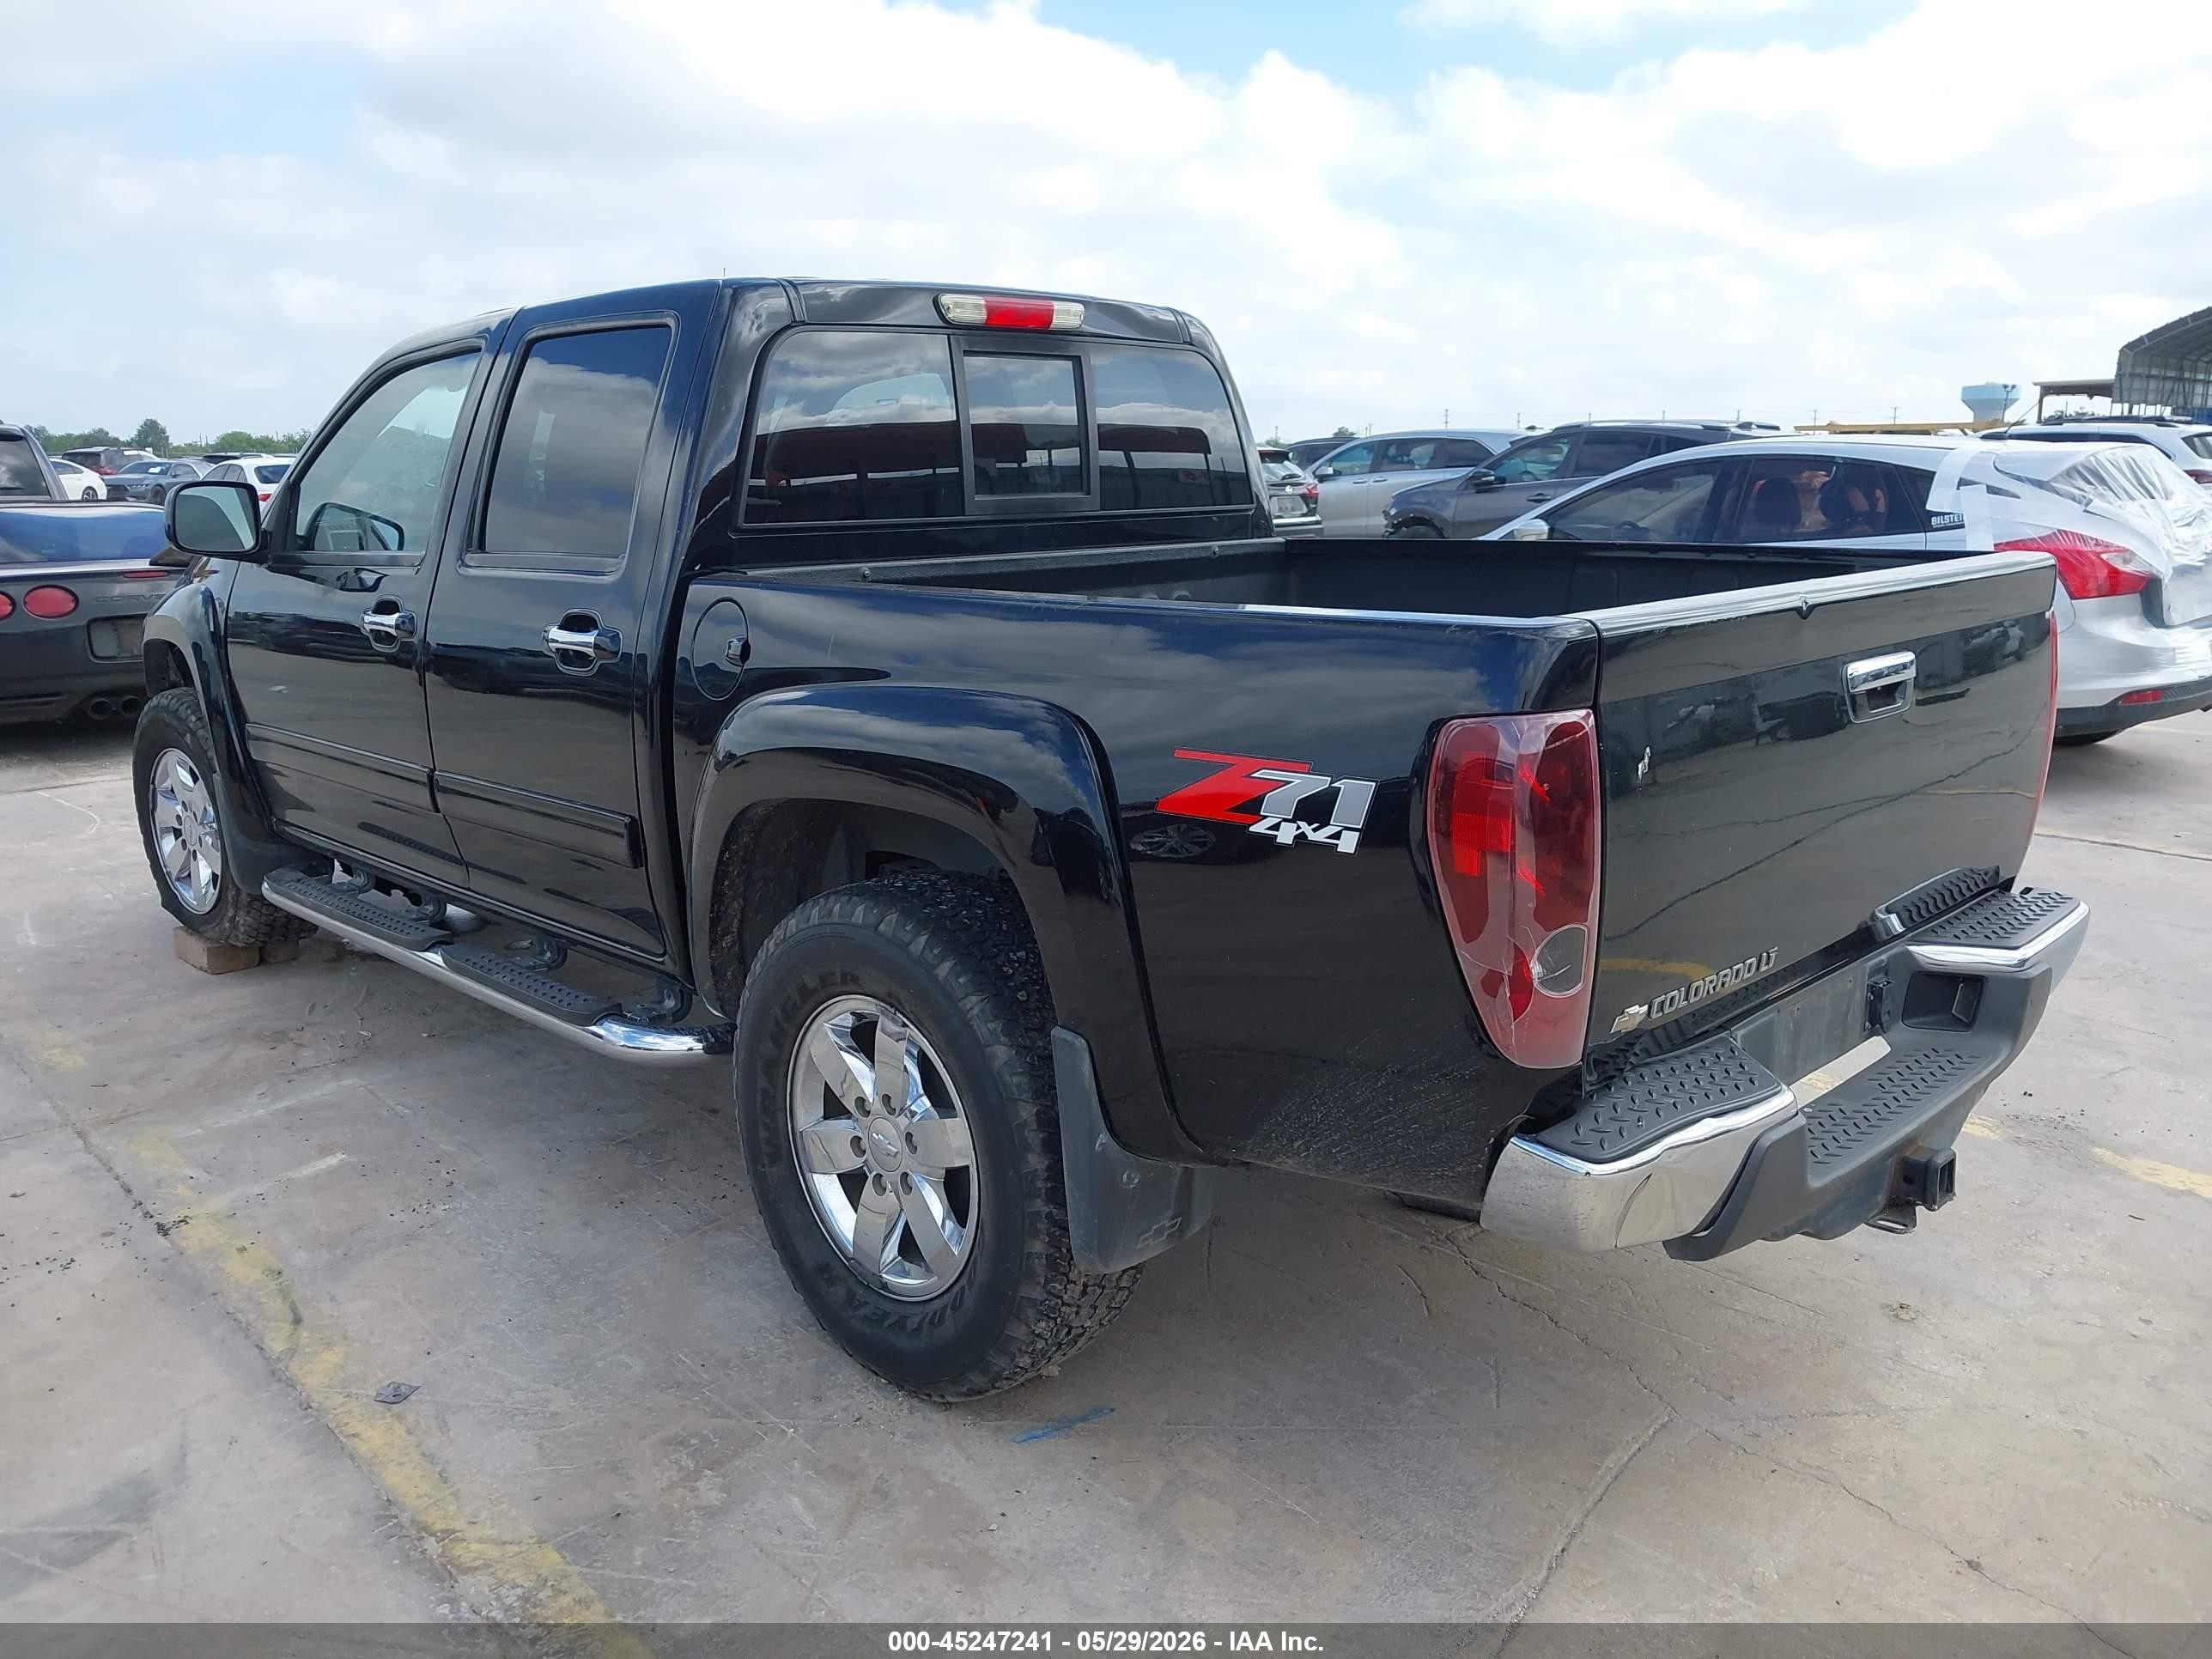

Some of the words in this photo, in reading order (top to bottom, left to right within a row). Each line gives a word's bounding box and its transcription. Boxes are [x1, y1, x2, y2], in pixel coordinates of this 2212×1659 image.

[1156, 748, 1378, 828] Z71
[1649, 957, 1757, 1020] COLORADO
[1760, 946, 1779, 971] LT
